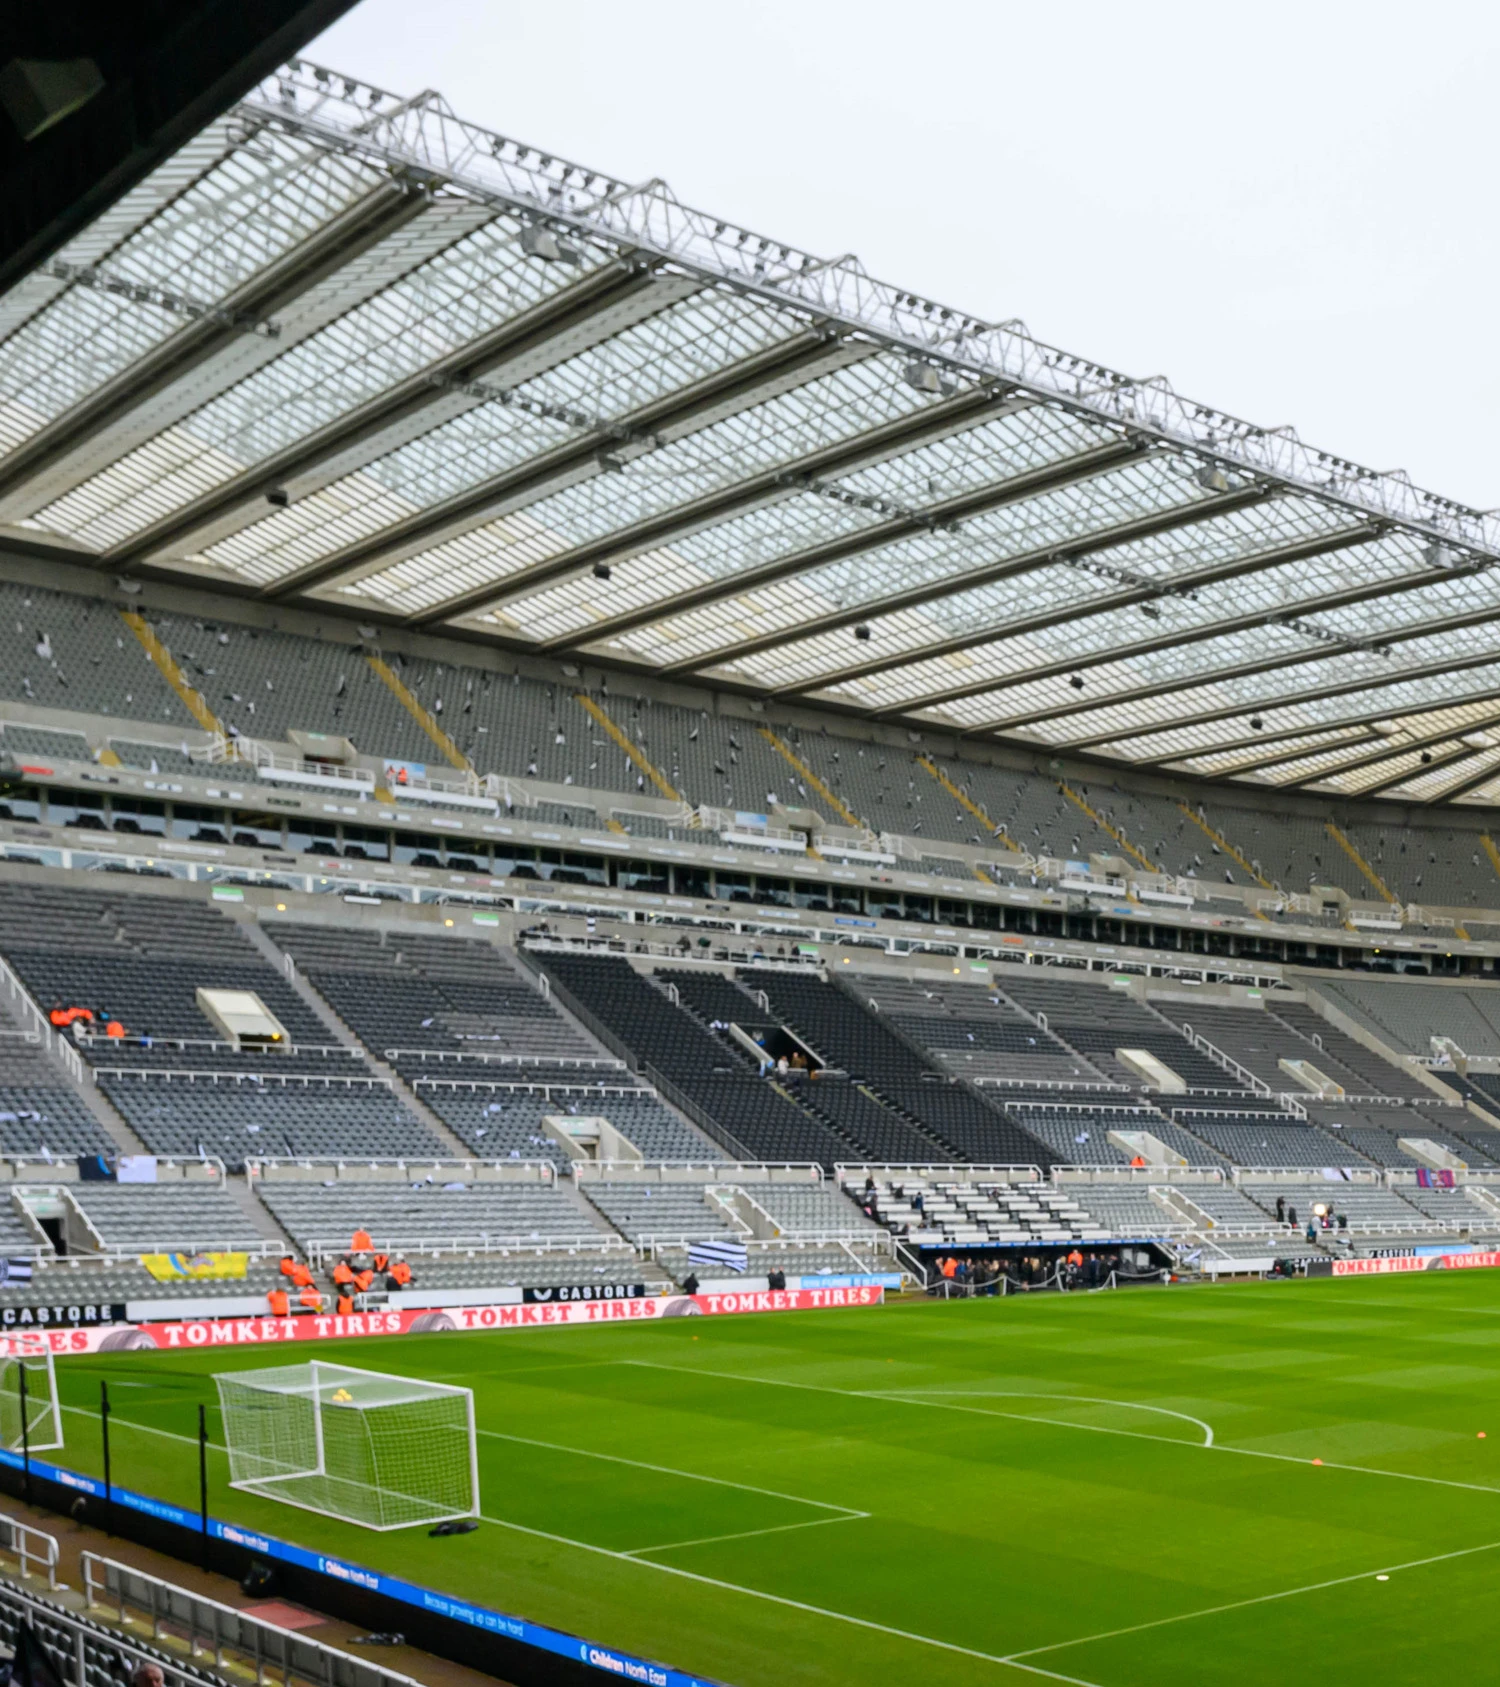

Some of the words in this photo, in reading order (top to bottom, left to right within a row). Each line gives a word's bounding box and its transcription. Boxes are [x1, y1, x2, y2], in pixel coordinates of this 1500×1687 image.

[1388, 1256, 1424, 1272] TIRES
[1450, 1252, 1497, 1267] TOMKET
[559, 1284, 635, 1300] CASTORE
[707, 1290, 800, 1313] TOMKET
[811, 1287, 871, 1306] TIRES
[2, 1303, 113, 1325] CASTORE
[462, 1304, 572, 1327] TOMKET
[585, 1299, 656, 1321] TIRES
[164, 1318, 299, 1347] TOMKET
[314, 1312, 402, 1337] TIRES
[0, 1331, 88, 1355] IRES
[589, 1648, 625, 1674] Children
[624, 1661, 649, 1682] North
[648, 1667, 668, 1687] East
